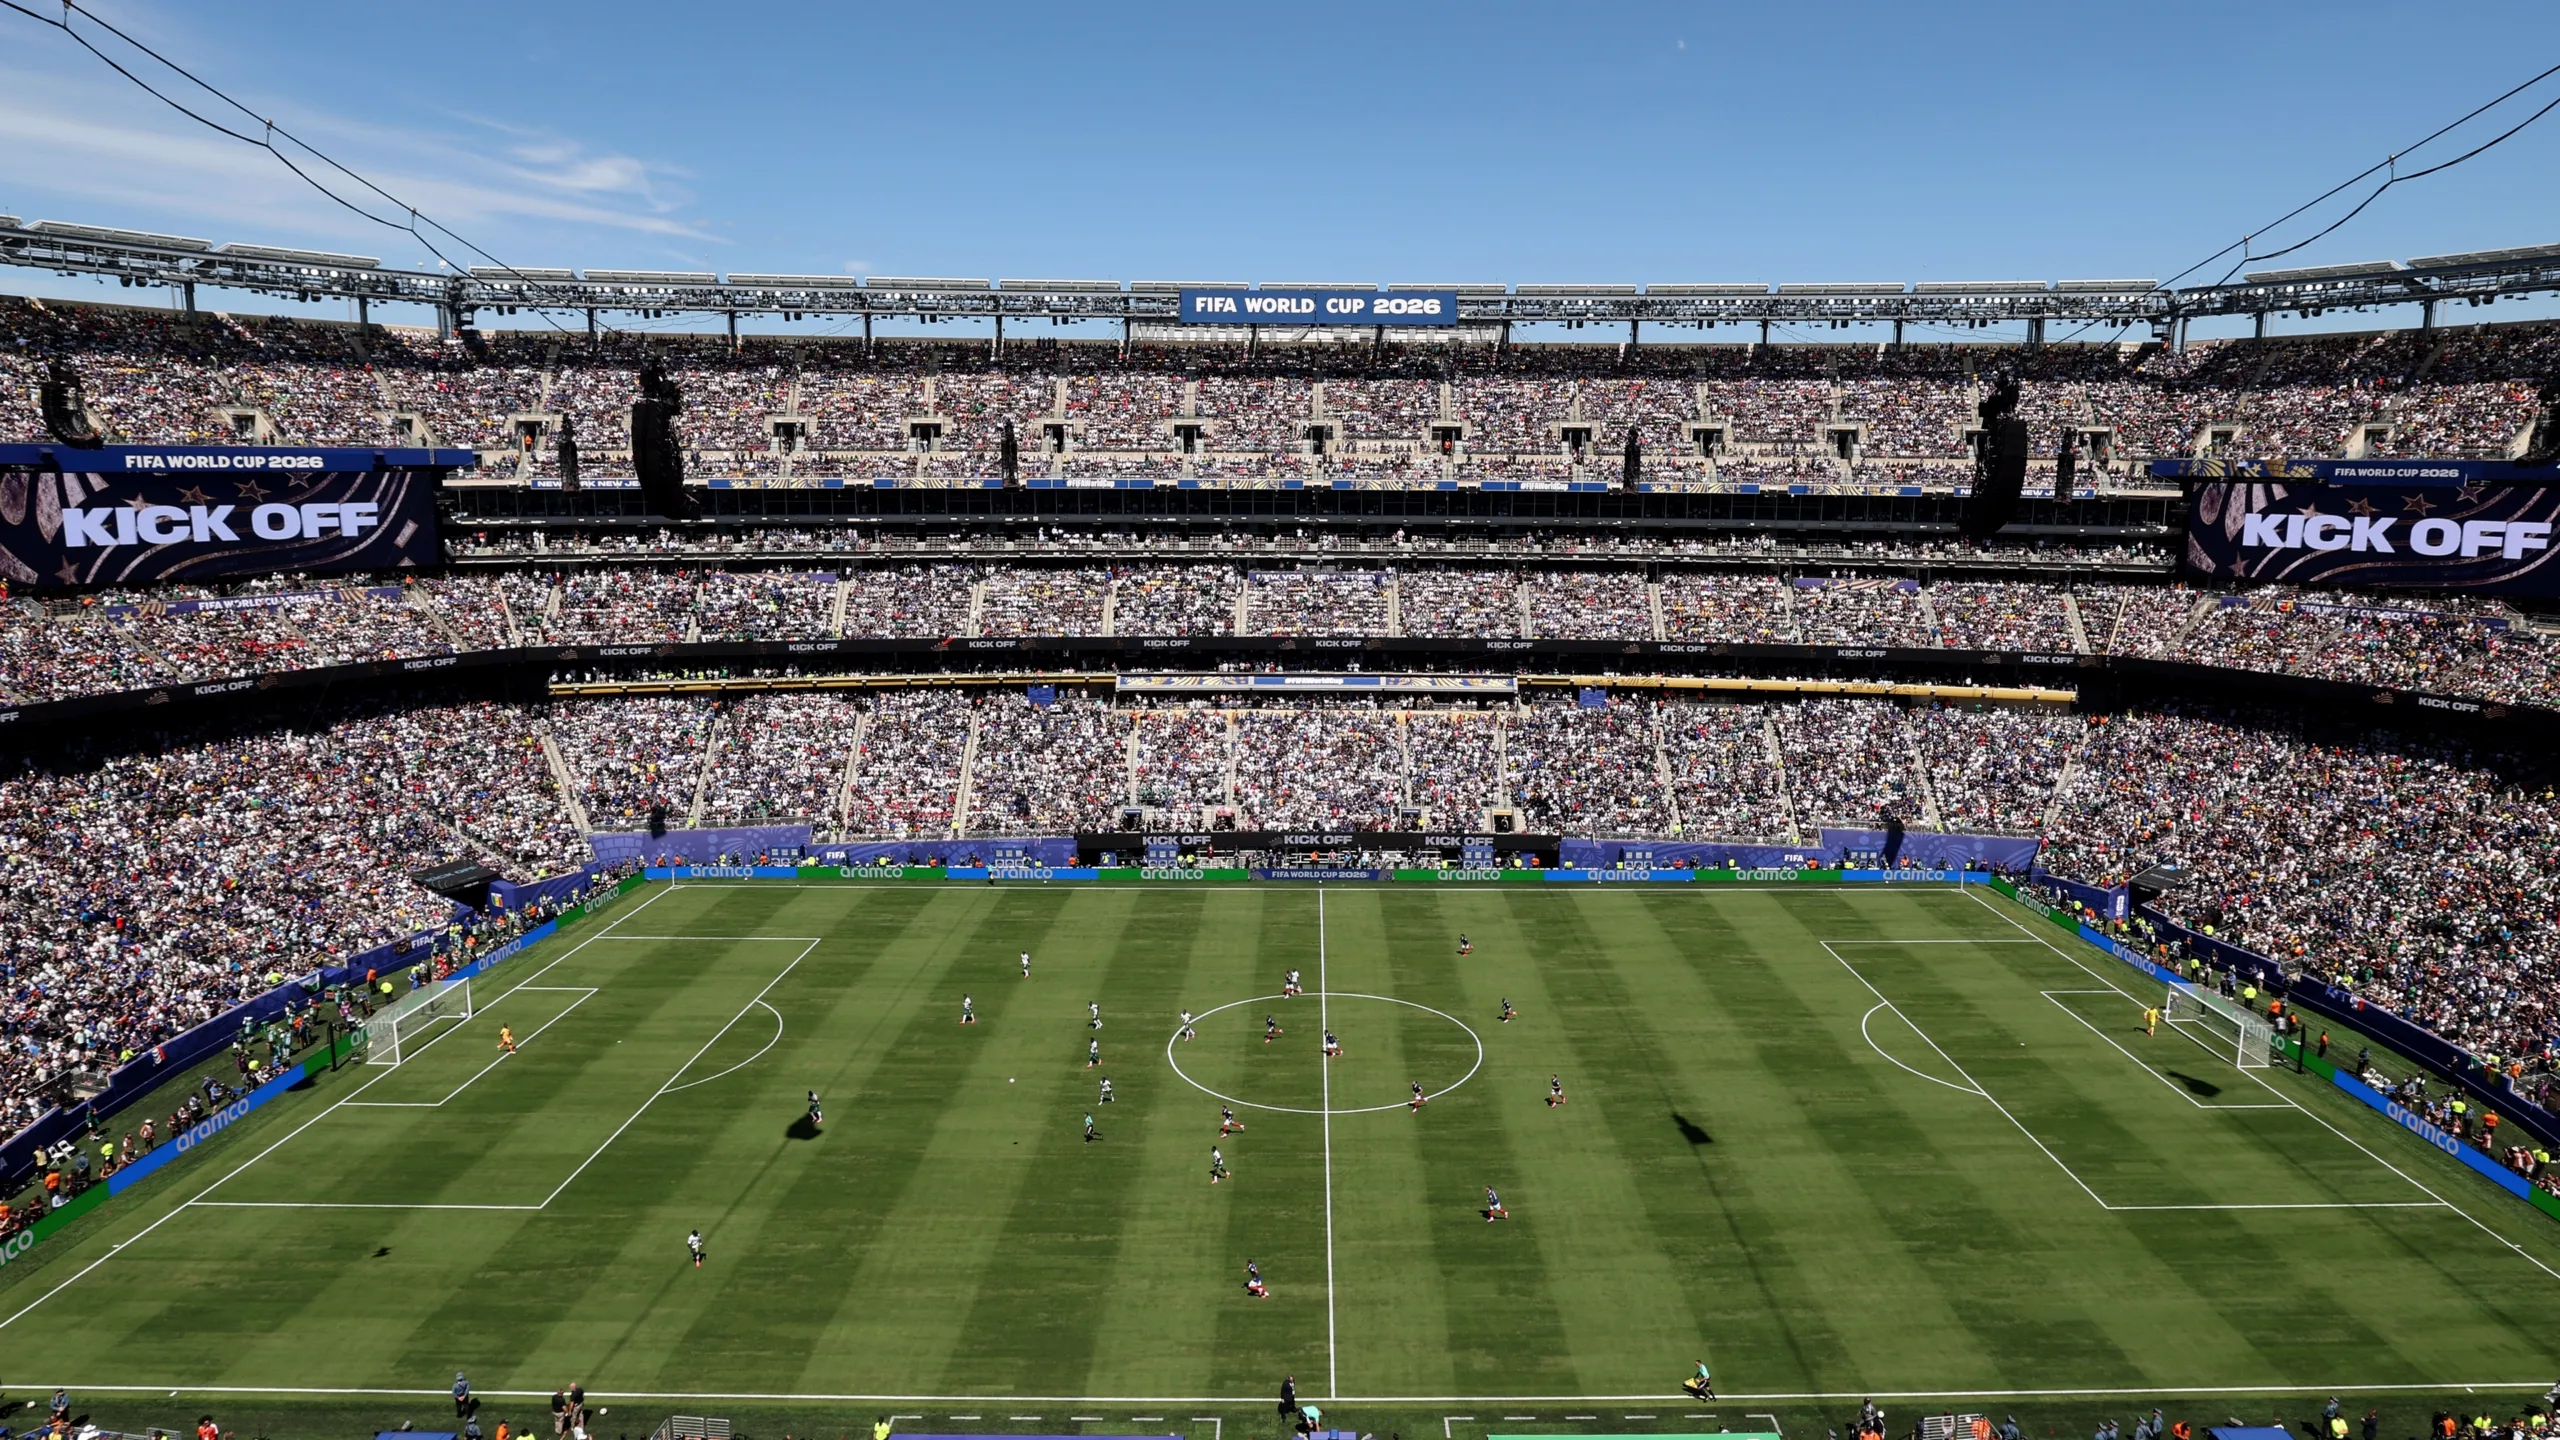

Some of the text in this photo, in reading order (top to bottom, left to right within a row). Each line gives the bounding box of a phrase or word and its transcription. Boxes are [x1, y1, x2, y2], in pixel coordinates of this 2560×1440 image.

[1195, 297, 1442, 315] FIFA WORLD CUP 2026
[125, 455, 323, 468] FIFA WORLD CUP 2026
[2334, 468, 2460, 478] FIFA WORLD CUP 2026
[1066, 479, 1116, 488] #FIFAWorldCup
[1520, 481, 1569, 491] #FIFAWorldCup
[62, 502, 378, 547] KICK OFF
[2242, 513, 2552, 560] KICK OFF
[199, 601, 222, 611] FIFA
[788, 643, 838, 653] KICK OFF
[968, 640, 1017, 649] KICK OFF
[1143, 639, 1191, 648] KICK OFF
[1315, 639, 1362, 648] KICK OFF
[1486, 641, 1533, 649] KICK OFF
[1660, 644, 1707, 653] KICK OFF
[600, 647, 651, 656] KICK OFF
[1837, 648, 1887, 658] KICK OFF
[404, 657, 457, 670] KICK OFF
[2022, 655, 2075, 664] KICK OFF
[195, 680, 253, 695] KICK OFF
[2418, 697, 2479, 713] KICK OFF
[0, 711, 20, 723] FF
[1142, 836, 1212, 845] KICK OFF
[1284, 835, 1353, 845] KICK OFF
[1425, 836, 1494, 846] KICK OFF
[826, 851, 846, 860] FIFA
[1784, 854, 1804, 863] FIFA
[690, 866, 754, 878] aramco
[839, 867, 903, 878] aramco
[1140, 868, 1204, 879] aramco
[1338, 871, 1367, 879] 2026
[1437, 869, 1501, 880] aramco
[1588, 869, 1650, 881] aramco
[1736, 869, 1798, 881] aramco
[1883, 869, 1945, 881] aramco
[584, 886, 620, 913] aramco
[2015, 890, 2051, 918] aramco
[411, 935, 431, 949] FIFA
[478, 939, 522, 971] aramco
[2112, 943, 2157, 976] aramco
[350, 1007, 403, 1047] aramco
[2232, 1011, 2286, 1051] aramco
[176, 1098, 249, 1152] aramco
[2386, 1101, 2459, 1155] aramco
